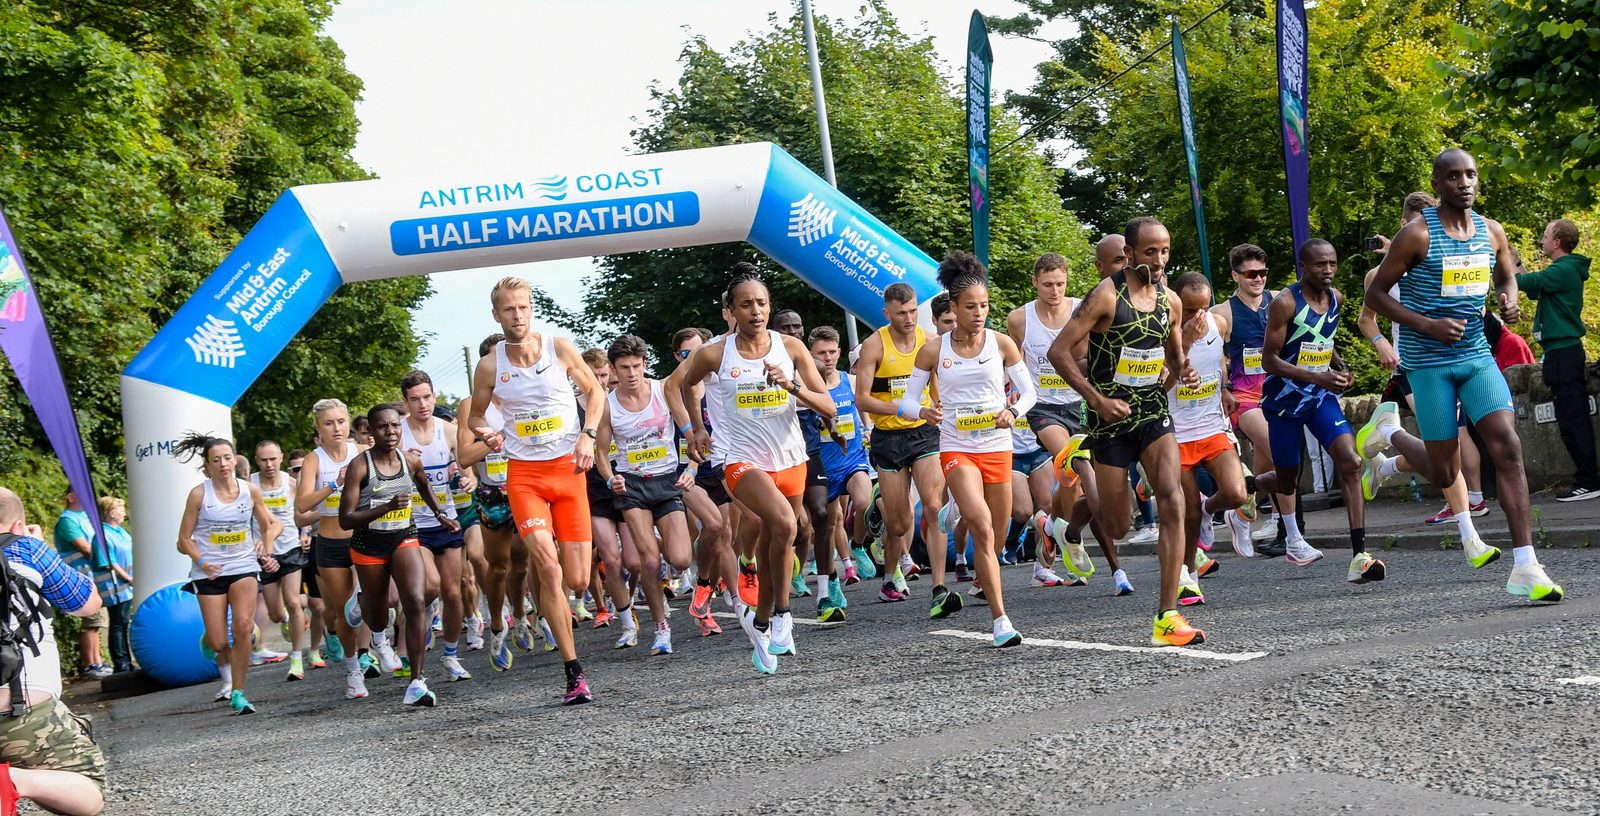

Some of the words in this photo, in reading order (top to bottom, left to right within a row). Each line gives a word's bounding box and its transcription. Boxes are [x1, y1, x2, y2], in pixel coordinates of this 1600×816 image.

[419, 182, 524, 208] ANTRIM
[576, 168, 663, 193] COAST
[417, 218, 498, 249] HALF
[506, 200, 675, 240] MARATHON
[823, 250, 858, 279] Borough
[830, 239, 879, 279] Antrim
[840, 225, 870, 252] Mid
[865, 245, 879, 258] &
[876, 251, 907, 280] East
[213, 269, 244, 300] Supported
[241, 261, 252, 271] by
[225, 283, 257, 314] Mid
[248, 274, 265, 288] &
[257, 247, 291, 279] East
[1453, 271, 1481, 282] PACE
[240, 277, 288, 326] Antrim
[252, 298, 286, 332] Borough
[282, 268, 312, 300] Council
[1127, 363, 1158, 374] YIMER
[738, 392, 787, 404] GEMECHU
[524, 421, 554, 434] PACE
[135, 442, 154, 461] Get
[635, 450, 660, 462] GRAY
[217, 535, 241, 543] ROSS
[519, 517, 547, 532] INEOS
